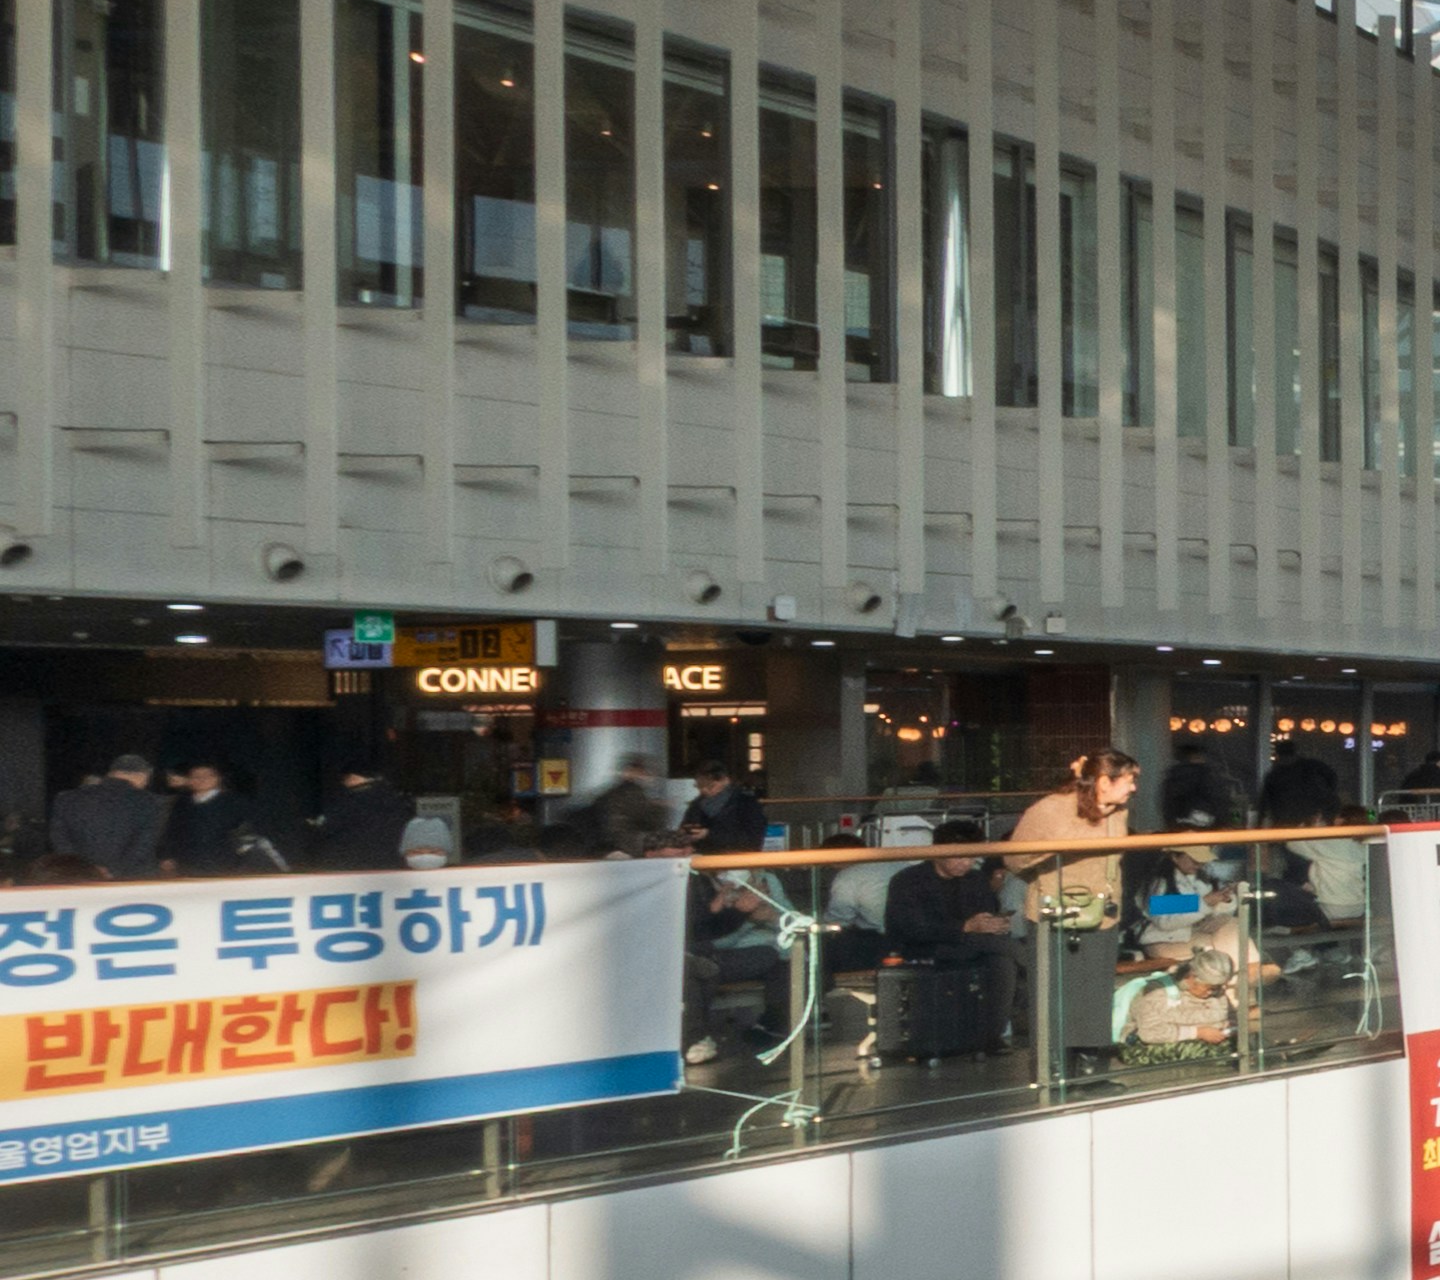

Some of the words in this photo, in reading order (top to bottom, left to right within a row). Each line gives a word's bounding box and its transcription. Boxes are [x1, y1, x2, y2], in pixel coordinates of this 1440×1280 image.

[418, 666, 538, 693] CONNE
[0, 901, 179, 989] 정은
[216, 881, 547, 971] 투명하게
[22, 982, 416, 1093] 반대한다!
